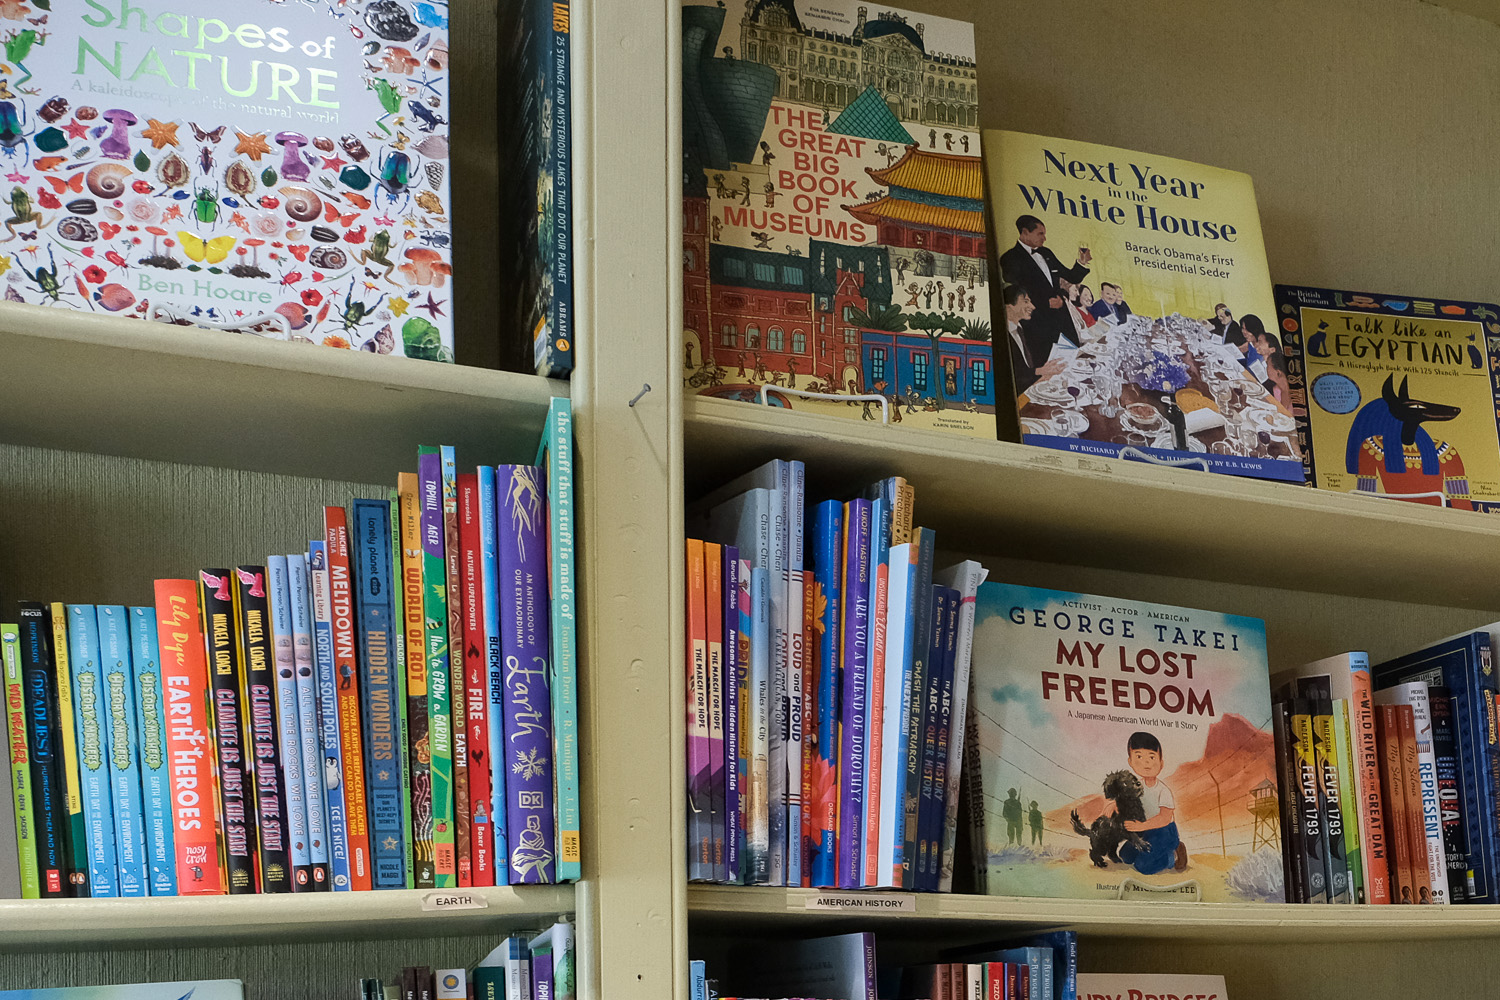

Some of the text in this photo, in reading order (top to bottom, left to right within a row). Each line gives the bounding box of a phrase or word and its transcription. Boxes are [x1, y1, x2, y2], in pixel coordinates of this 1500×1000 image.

[80, 0, 336, 60] Shapes of
[70, 35, 340, 109] NATURE
[770, 106, 823, 131] THE
[556, 36, 567, 284] 25 STRANGE AND MYSTERIOUS LAKES THAT DOT OUR PLANET
[778, 129, 866, 158] GREAT
[794, 152, 839, 175] BIG
[1042, 149, 1205, 199] Next Year
[778, 170, 859, 199] BOOK
[1108, 187, 1148, 203] in the
[793, 195, 830, 215] OF
[1017, 183, 1237, 243] White House
[723, 206, 866, 242] MUSEUMS
[1125, 242, 1235, 267] Barack Obama's First
[1134, 257, 1230, 279] Presidential Seder
[137, 273, 273, 305] Ben Hoare
[559, 301, 567, 337] ABRAMS
[1434, 328, 1452, 339] an
[1335, 334, 1463, 366] EGYPTIAN
[331, 564, 352, 659] MELTDOWN
[1009, 606, 1239, 651] GEORGE TAKEI
[1056, 638, 1197, 679] MY LOST
[367, 630, 393, 762] HIDDEN WONDERS
[1041, 671, 1215, 717] FREEDOM
[168, 676, 201, 831] EARTH HEROES
[1302, 766, 1319, 836] FEVER 1793
[436, 895, 472, 906] EARTH
[817, 898, 903, 908] AMERICAN HISTORY
